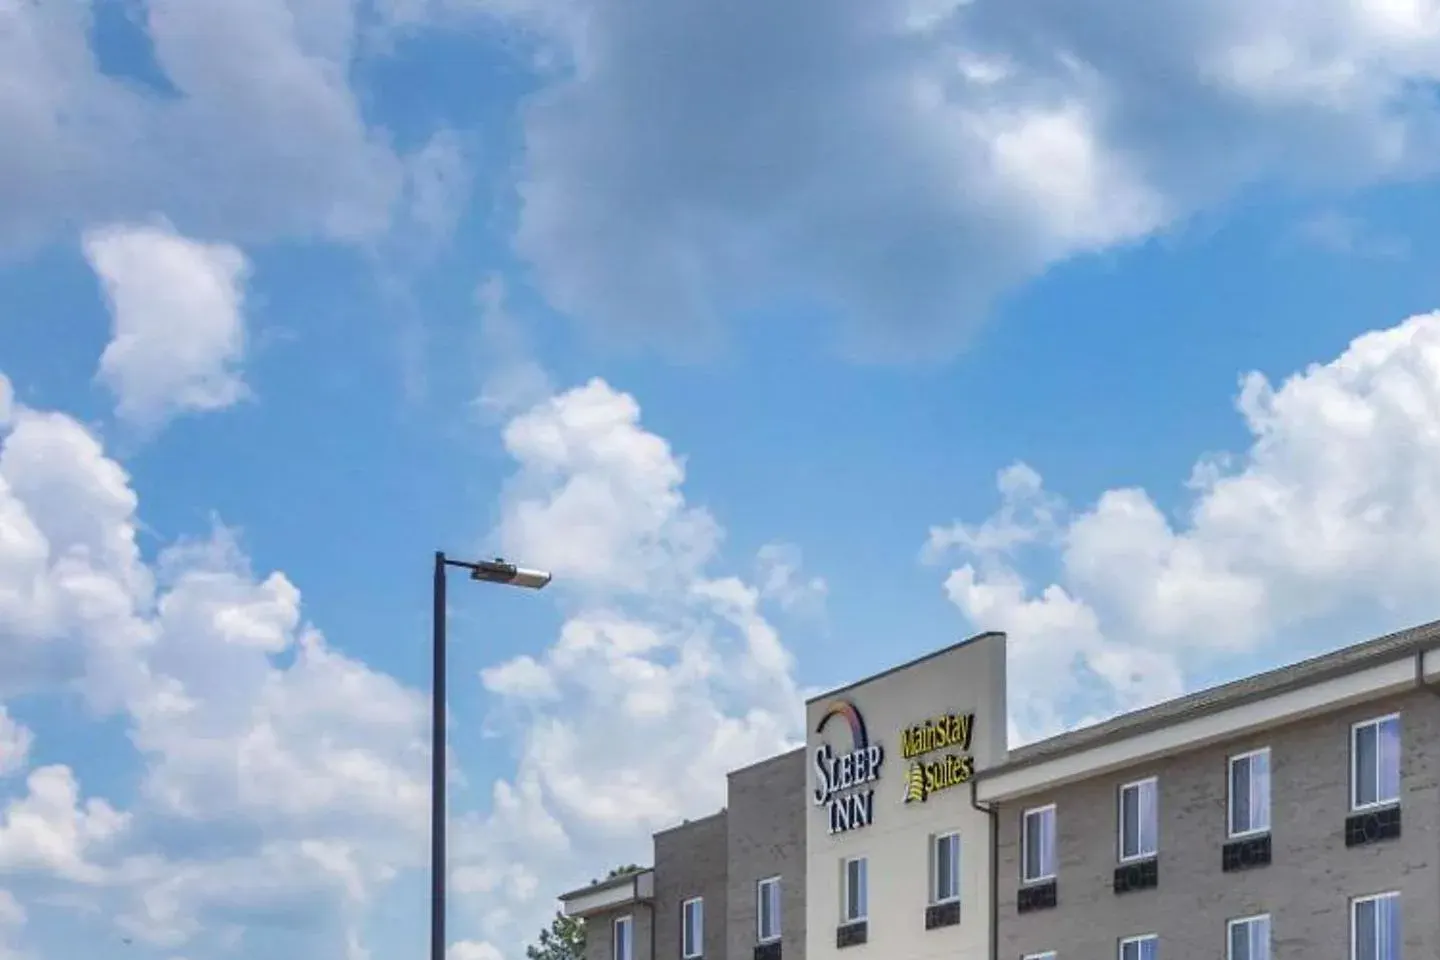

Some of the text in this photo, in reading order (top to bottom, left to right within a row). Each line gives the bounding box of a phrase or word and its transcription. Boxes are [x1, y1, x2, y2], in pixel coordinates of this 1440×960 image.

[902, 713, 974, 758] MainStay
[925, 755, 974, 794] Suites
[827, 790, 874, 835] INN
